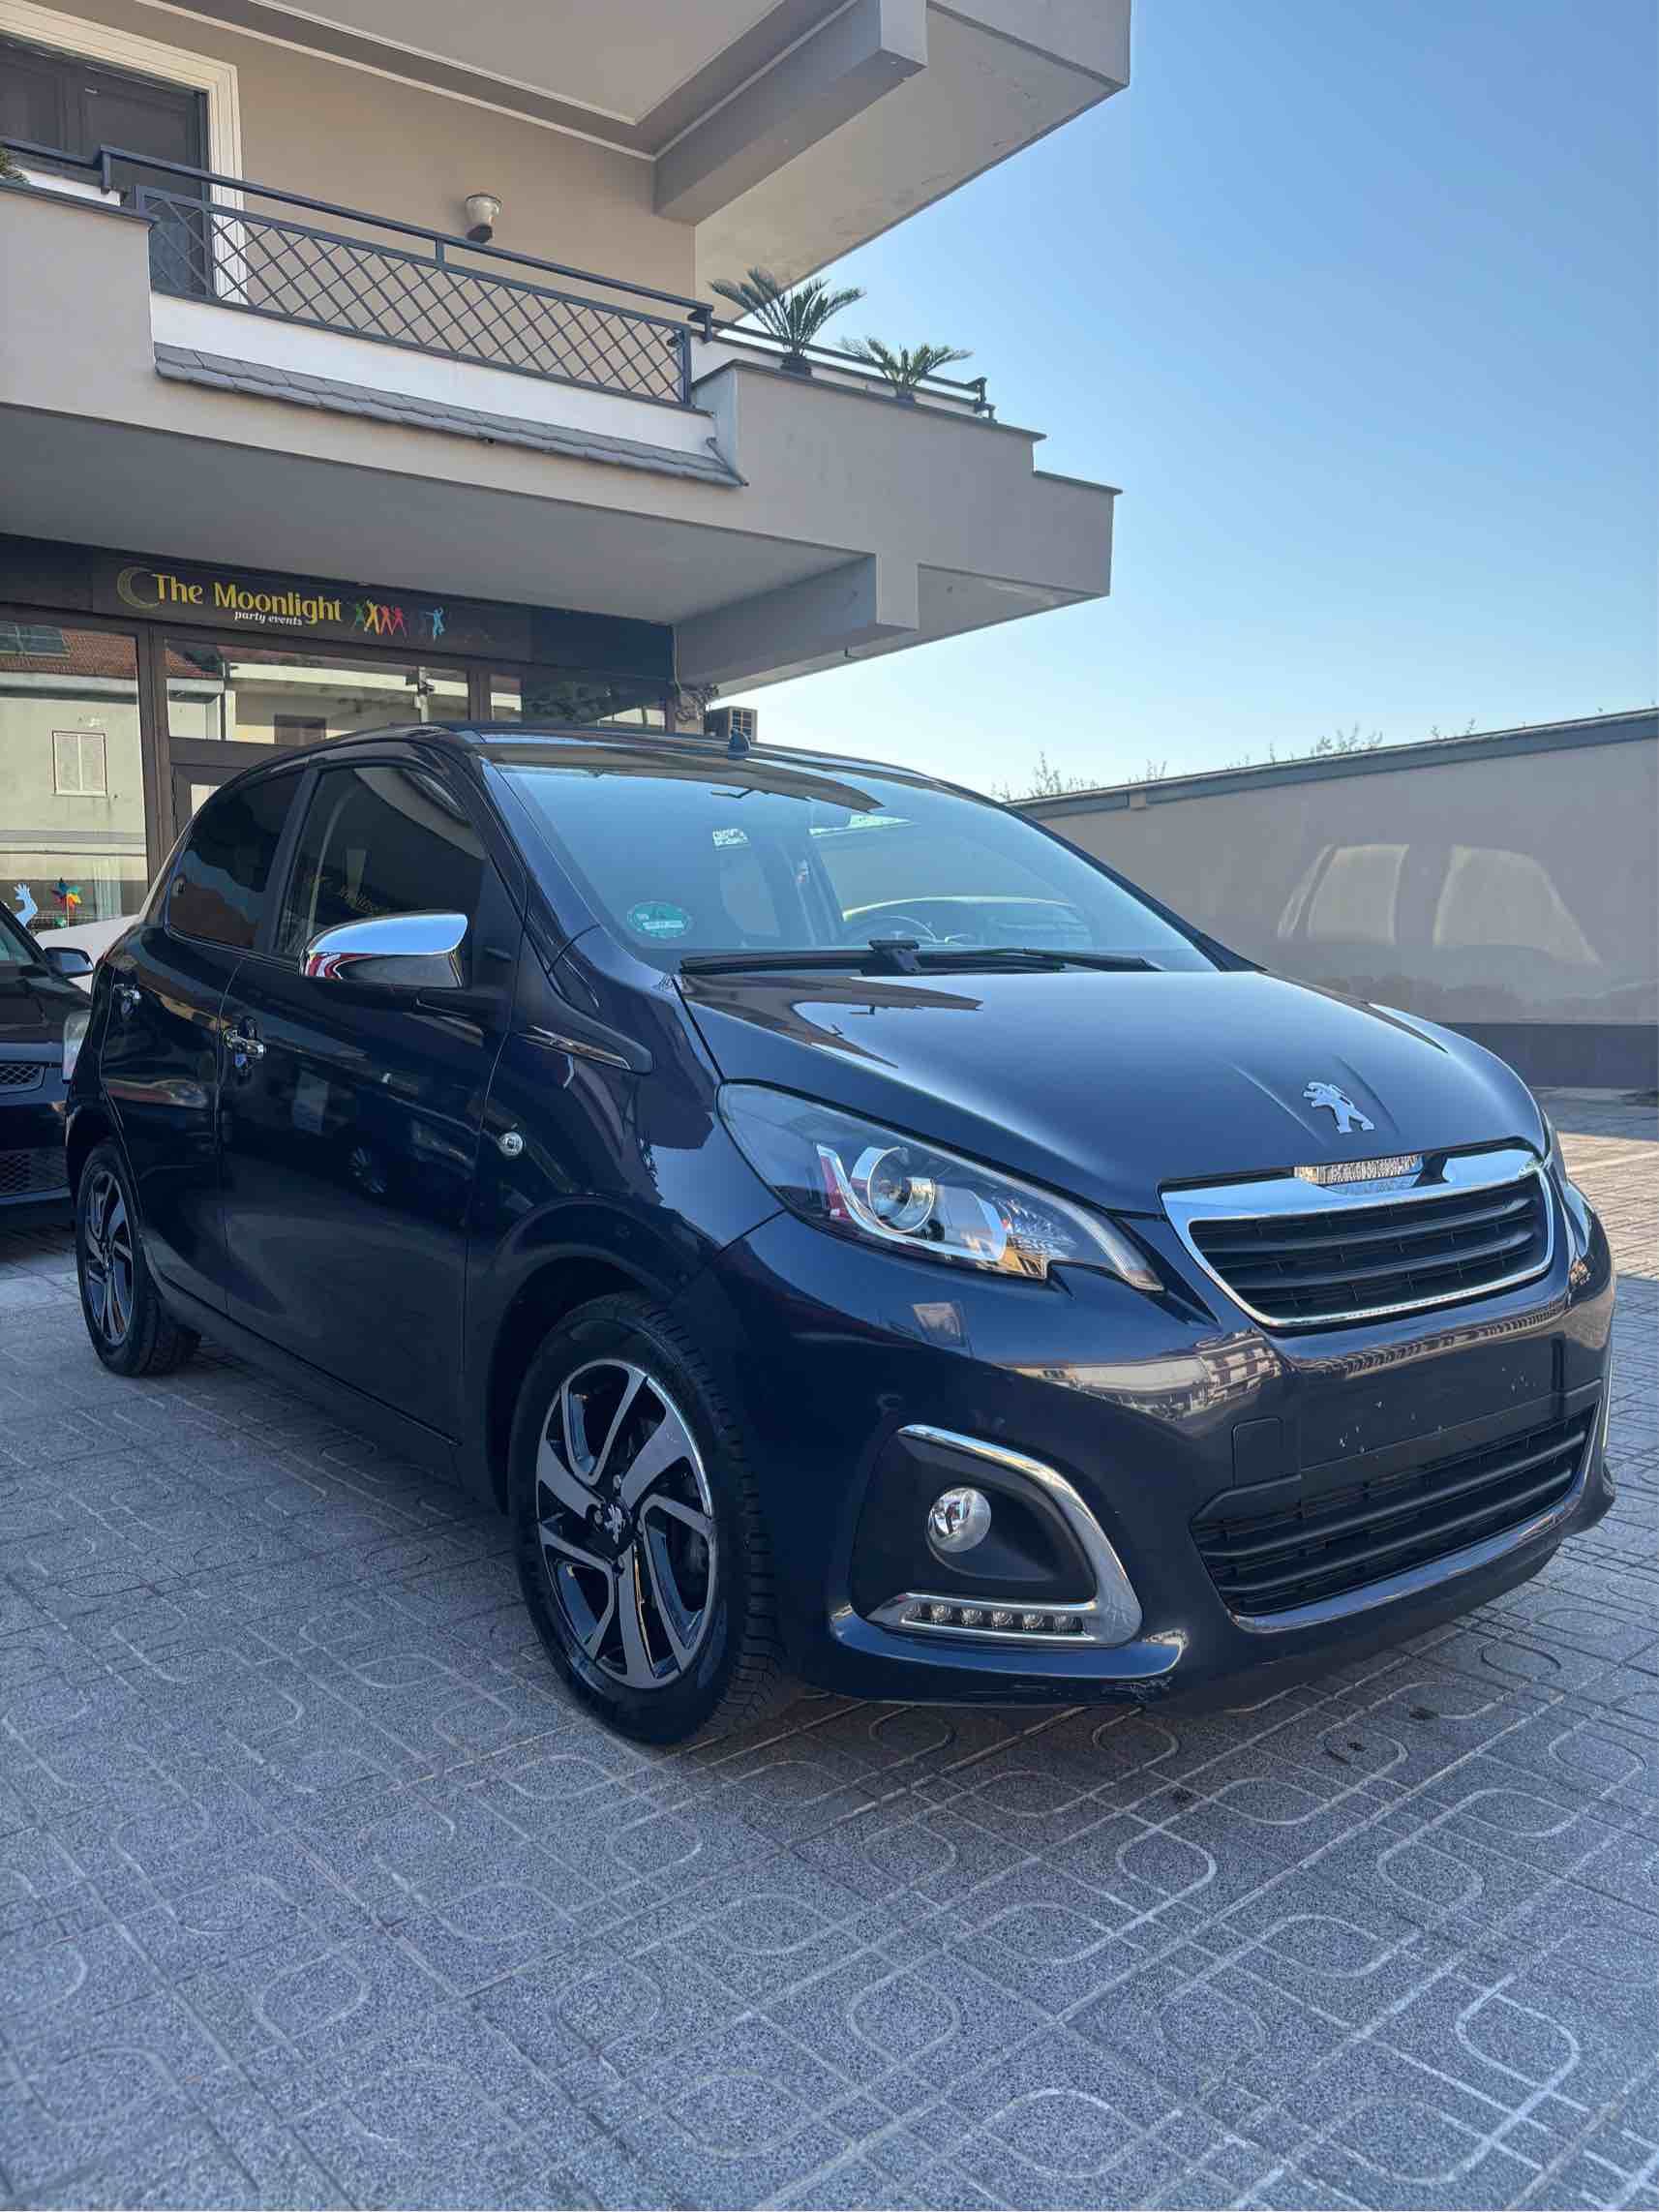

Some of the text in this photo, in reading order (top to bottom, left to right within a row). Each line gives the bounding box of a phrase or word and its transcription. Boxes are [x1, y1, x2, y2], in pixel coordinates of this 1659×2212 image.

[152, 573, 342, 624] The Moonlight
[233, 611, 303, 626] party events
